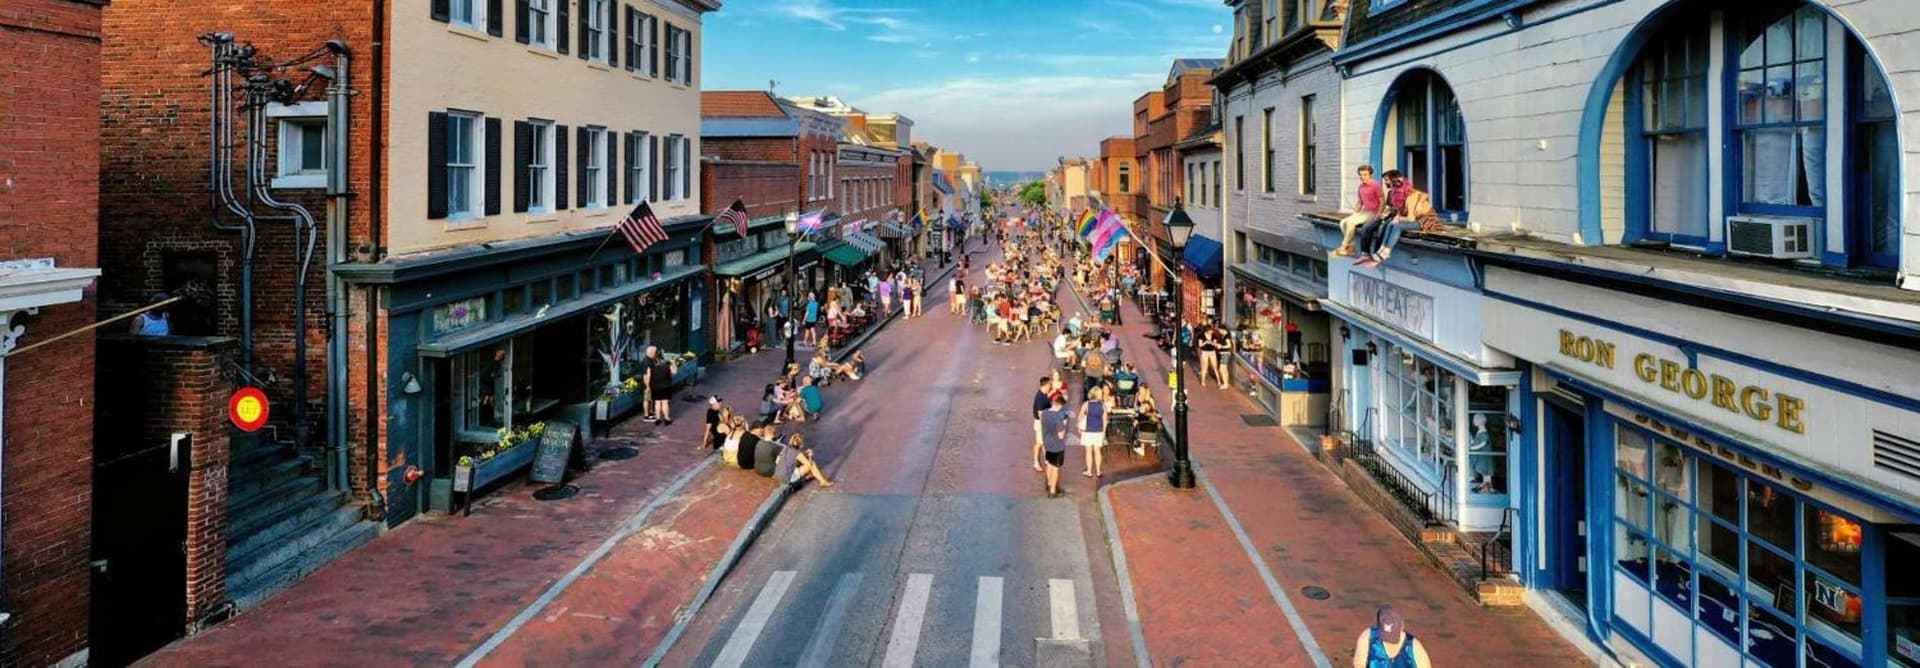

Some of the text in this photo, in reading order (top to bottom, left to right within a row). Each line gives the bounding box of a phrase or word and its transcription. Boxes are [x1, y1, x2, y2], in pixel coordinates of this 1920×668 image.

[1362, 280, 1408, 320] WHEAT
[1558, 329, 1805, 434] RON GEORGE
